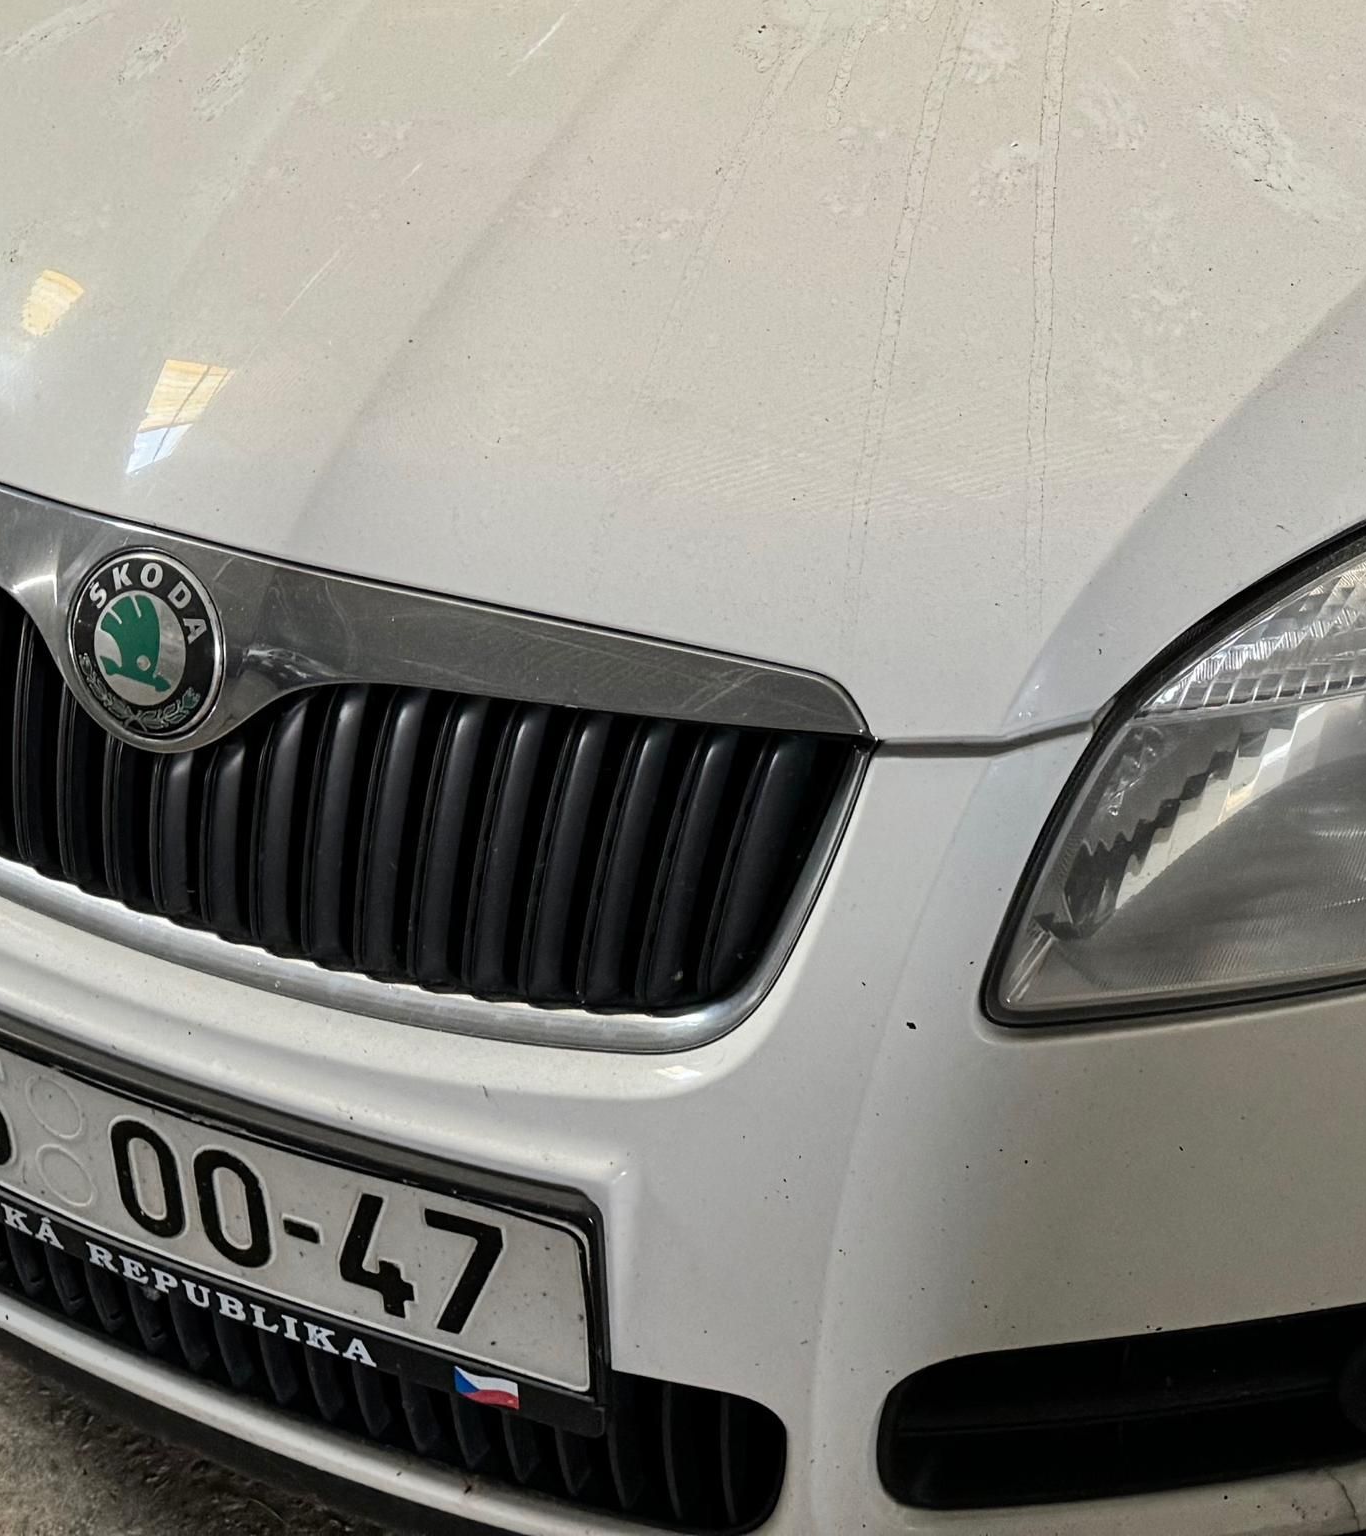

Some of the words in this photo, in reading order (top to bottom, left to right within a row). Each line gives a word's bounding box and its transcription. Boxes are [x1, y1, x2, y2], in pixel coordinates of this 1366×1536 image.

[88, 562, 208, 645] ŠKODA
[109, 1118, 505, 1335] 00-47
[87, 1239, 378, 1368] REPUBLIKA
